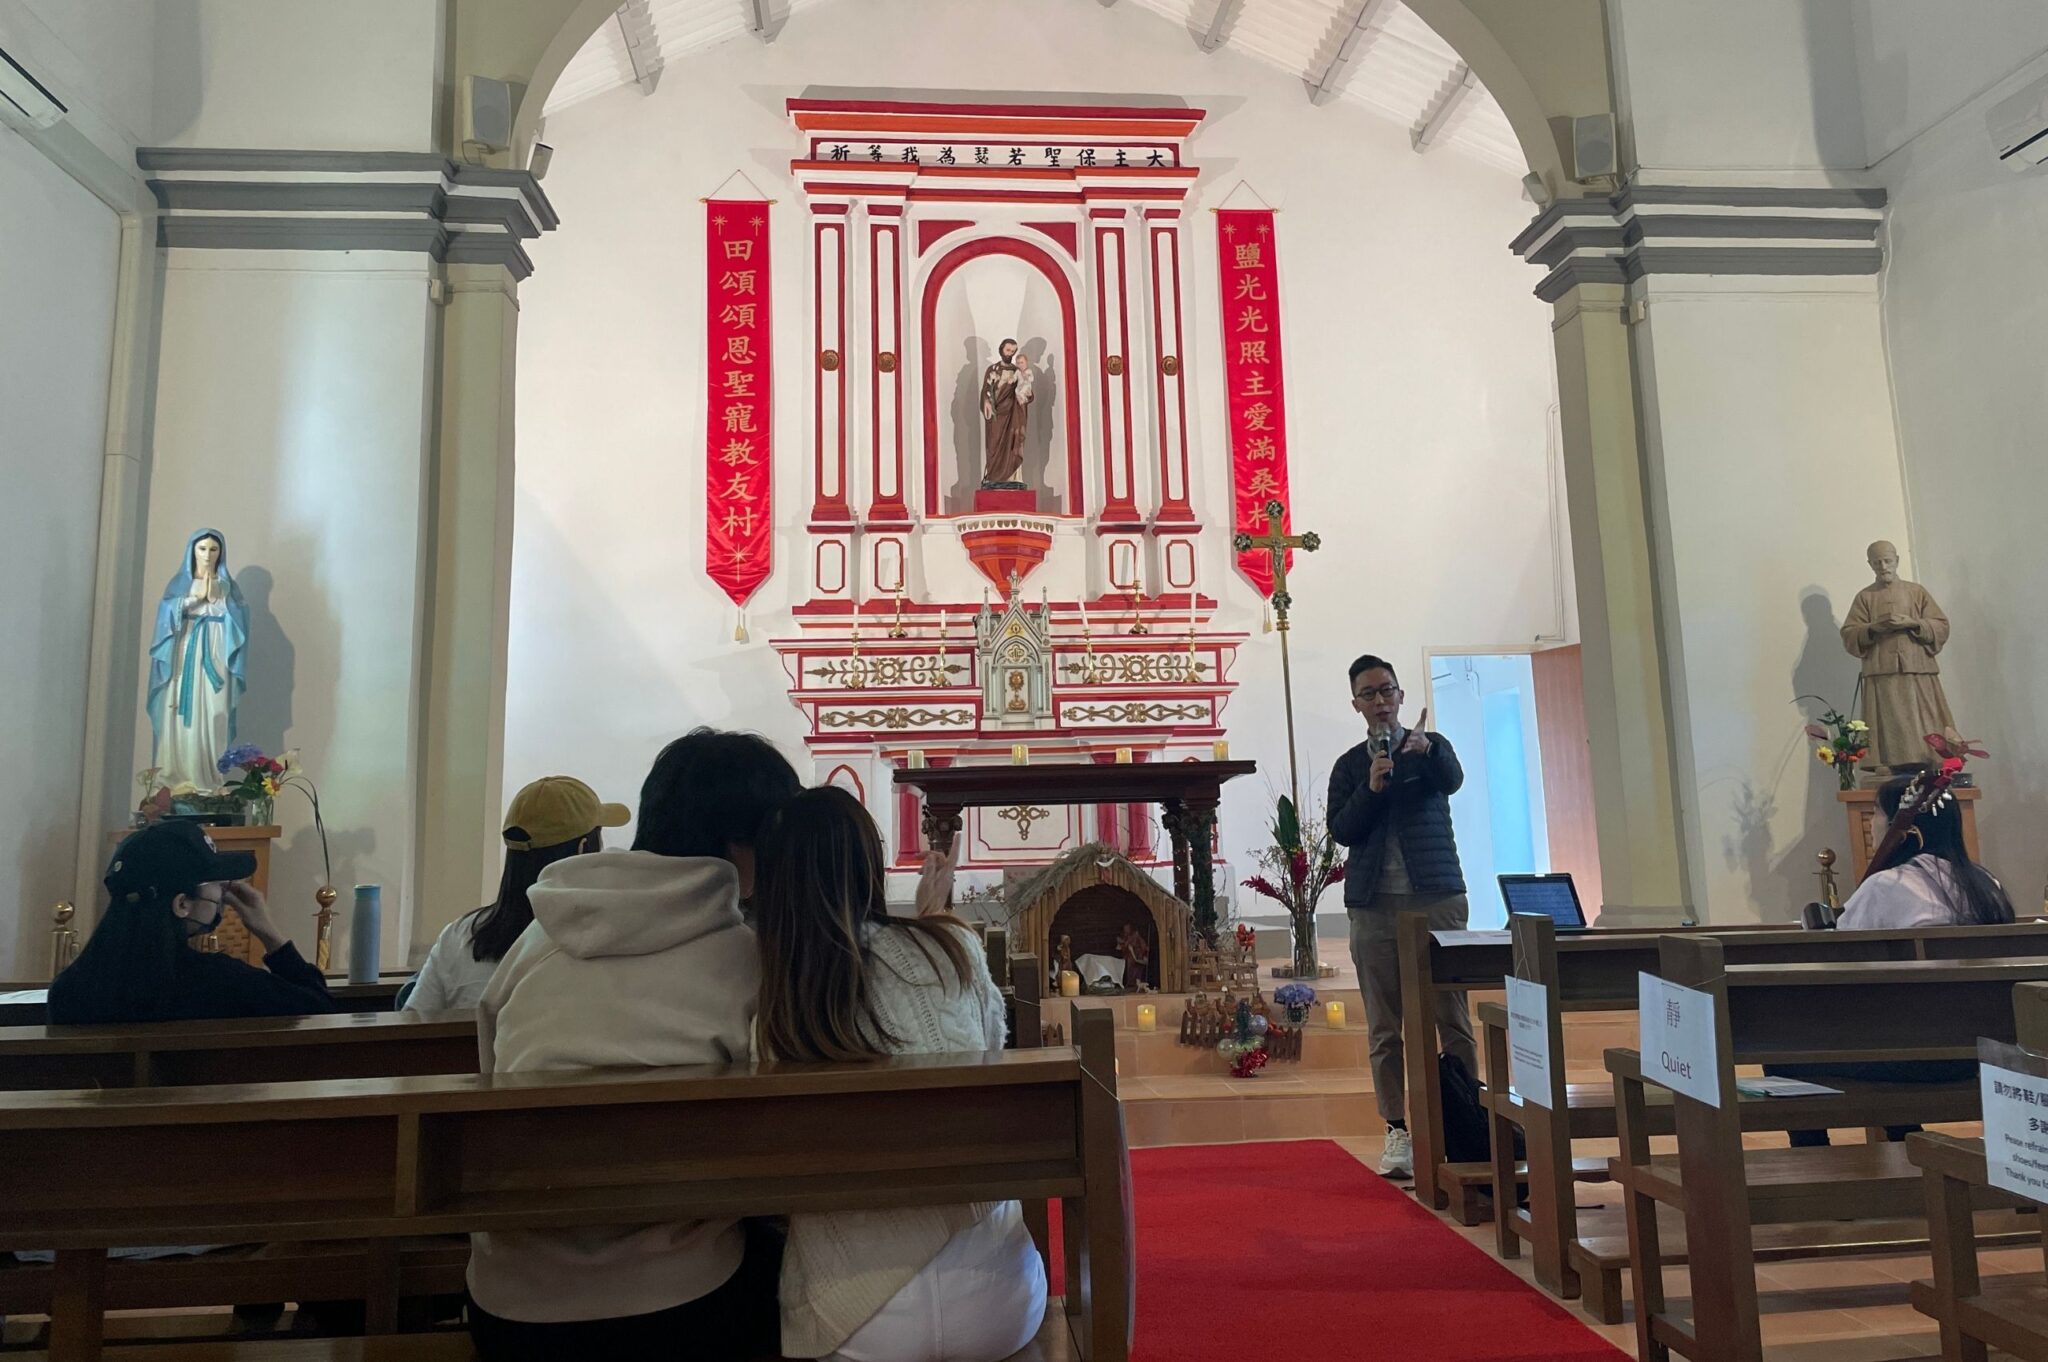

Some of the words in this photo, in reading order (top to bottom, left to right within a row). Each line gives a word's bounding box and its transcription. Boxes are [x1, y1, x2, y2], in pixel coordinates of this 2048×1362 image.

[719, 239, 758, 538] 田頌頌恩聖寵教友村
[1665, 998, 1681, 1029] 靜
[1661, 1050, 1692, 1080] Quiet
